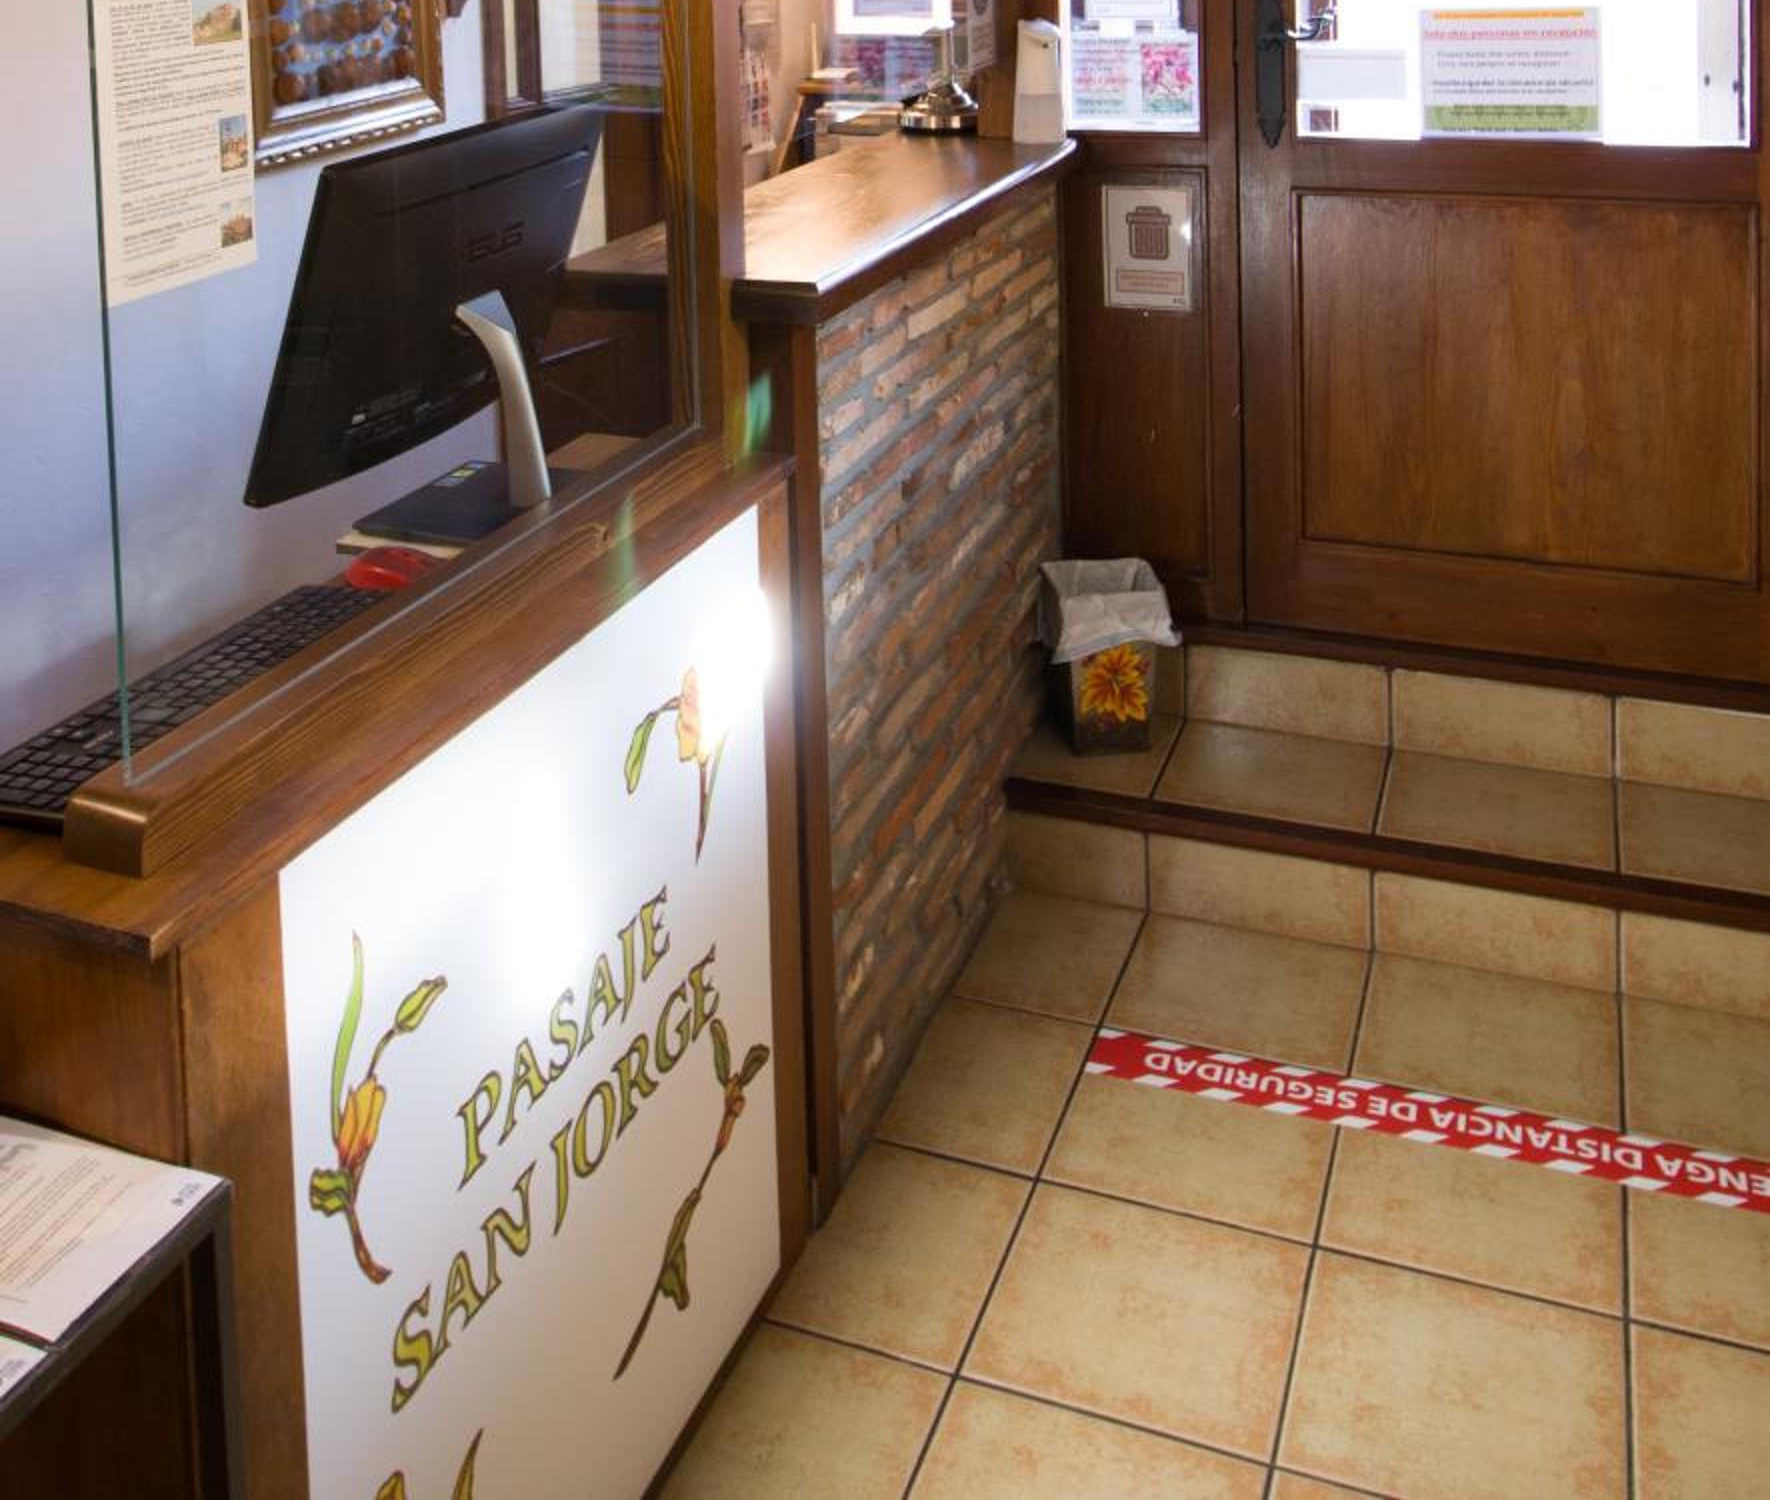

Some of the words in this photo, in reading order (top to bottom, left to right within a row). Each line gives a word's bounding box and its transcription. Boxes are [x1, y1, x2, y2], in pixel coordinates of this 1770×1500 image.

[456, 884, 670, 1191] PASAJE
[1144, 1050, 1356, 1112] SEGURIDAD
[1369, 1095, 1416, 1124] DE
[1430, 1112, 1644, 1172] DISTANCIA
[391, 1160, 536, 1414] SAN
[549, 943, 720, 1236] JORGE
